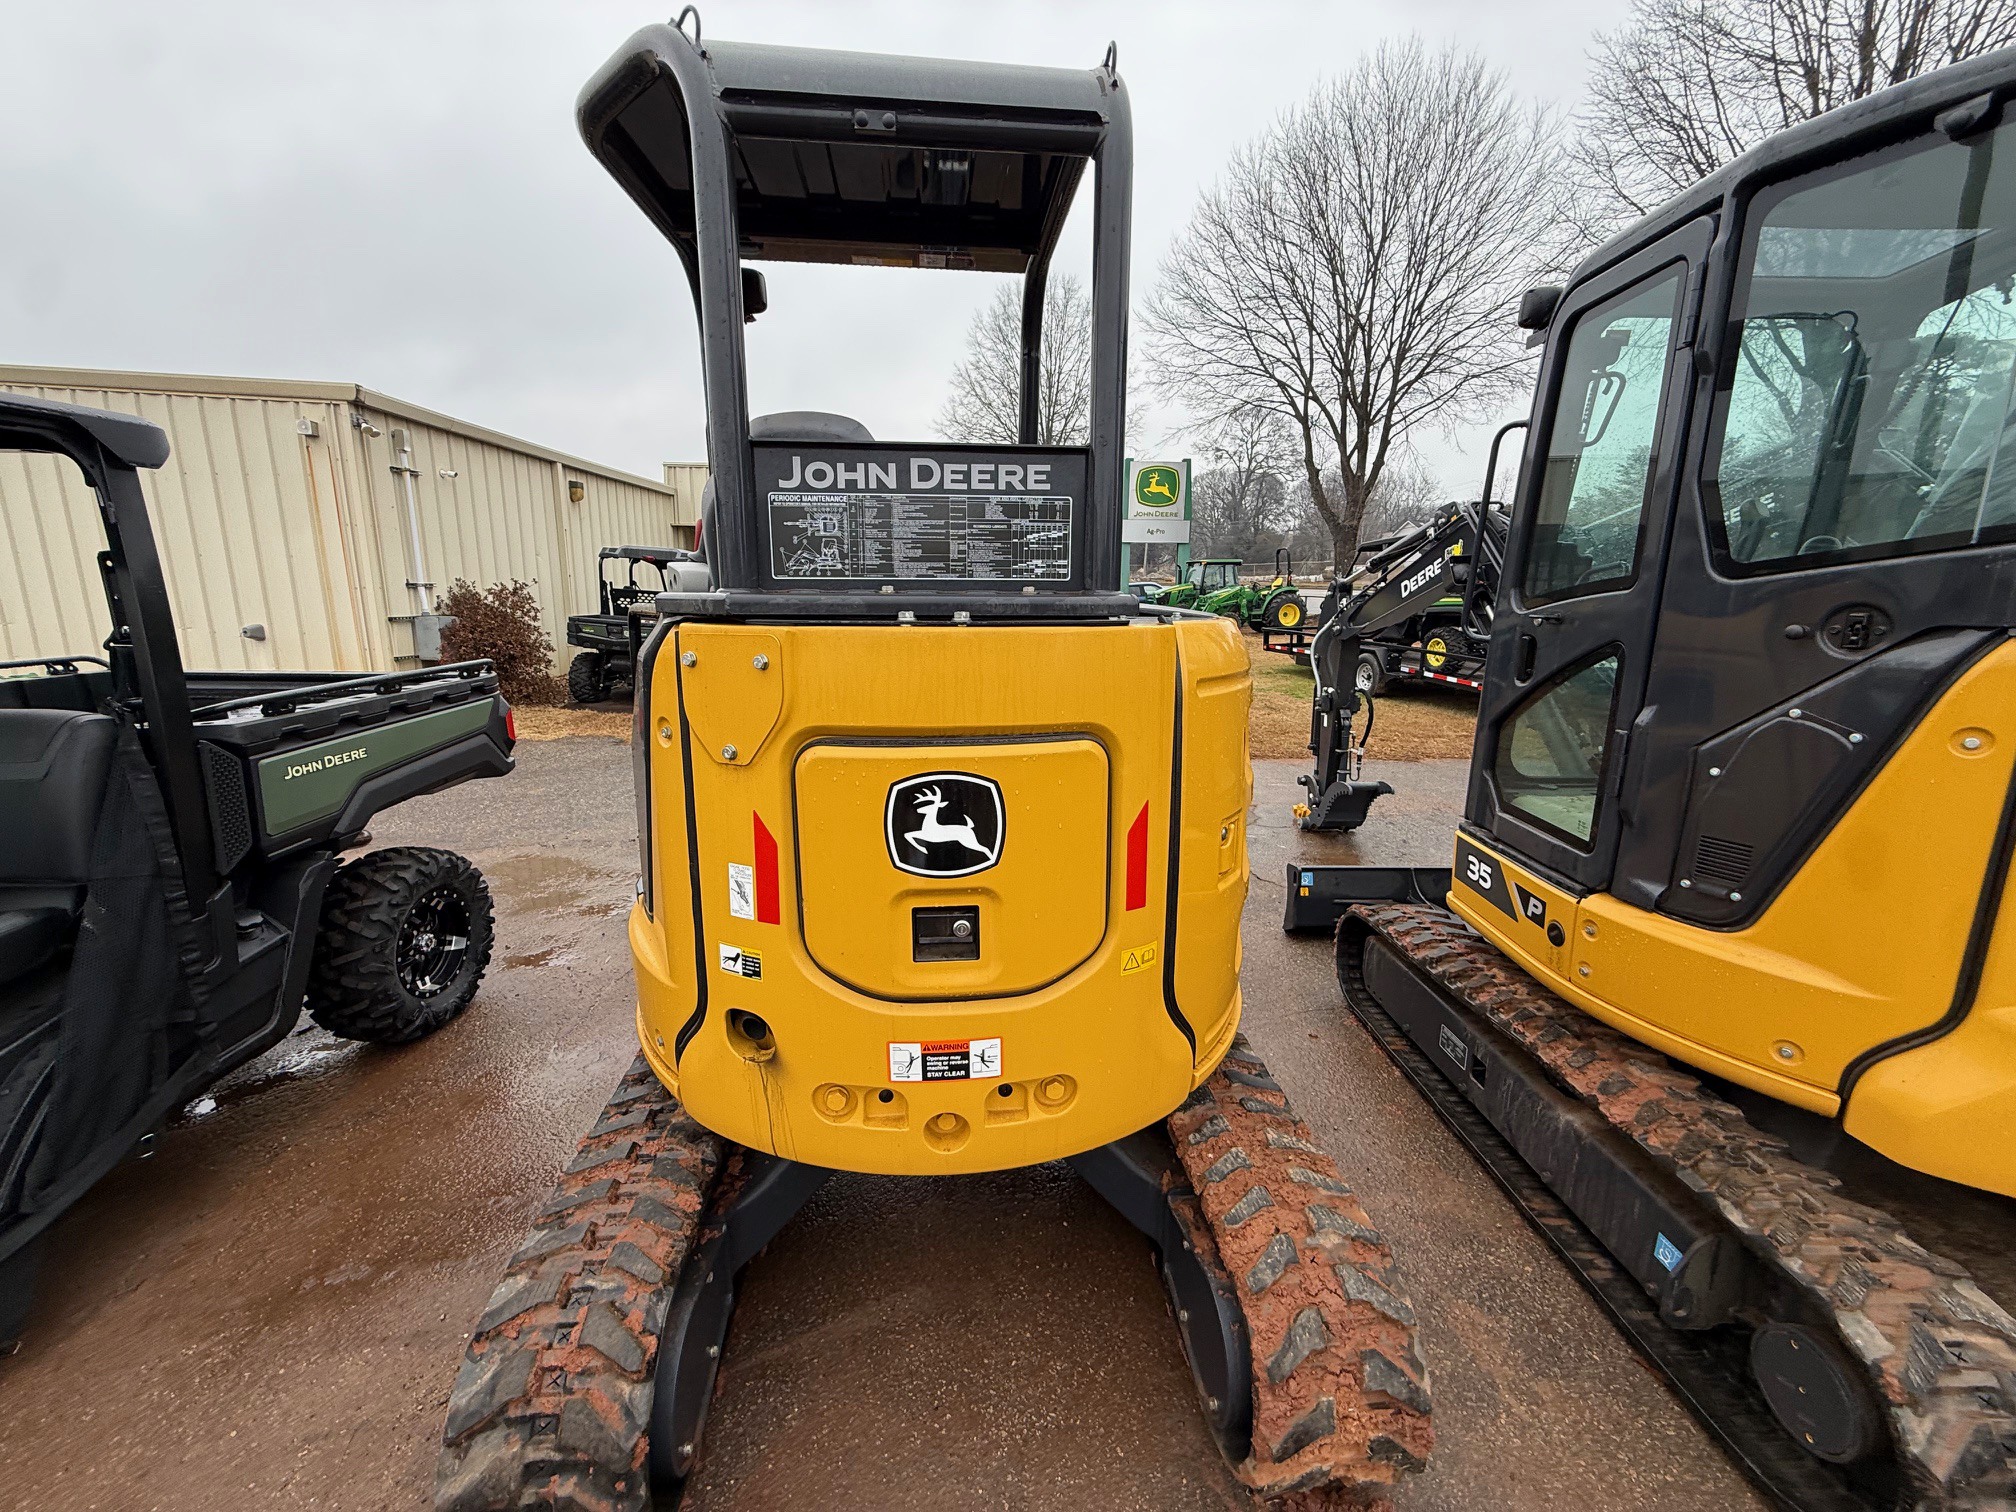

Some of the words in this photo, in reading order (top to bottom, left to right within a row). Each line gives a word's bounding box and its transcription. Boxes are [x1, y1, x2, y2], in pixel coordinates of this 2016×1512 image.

[779, 456, 897, 489] JOHN
[910, 457, 1051, 491] DEERE
[770, 494, 801, 502] PERIODIC
[802, 495, 848, 503] MAINTENANCE
[1400, 557, 1443, 599] DEERE
[284, 760, 323, 780] JOHN
[323, 747, 368, 768] DEERE
[1466, 854, 1492, 890] 35
[1526, 896, 1543, 917] P
[930, 1042, 968, 1051] WARNING
